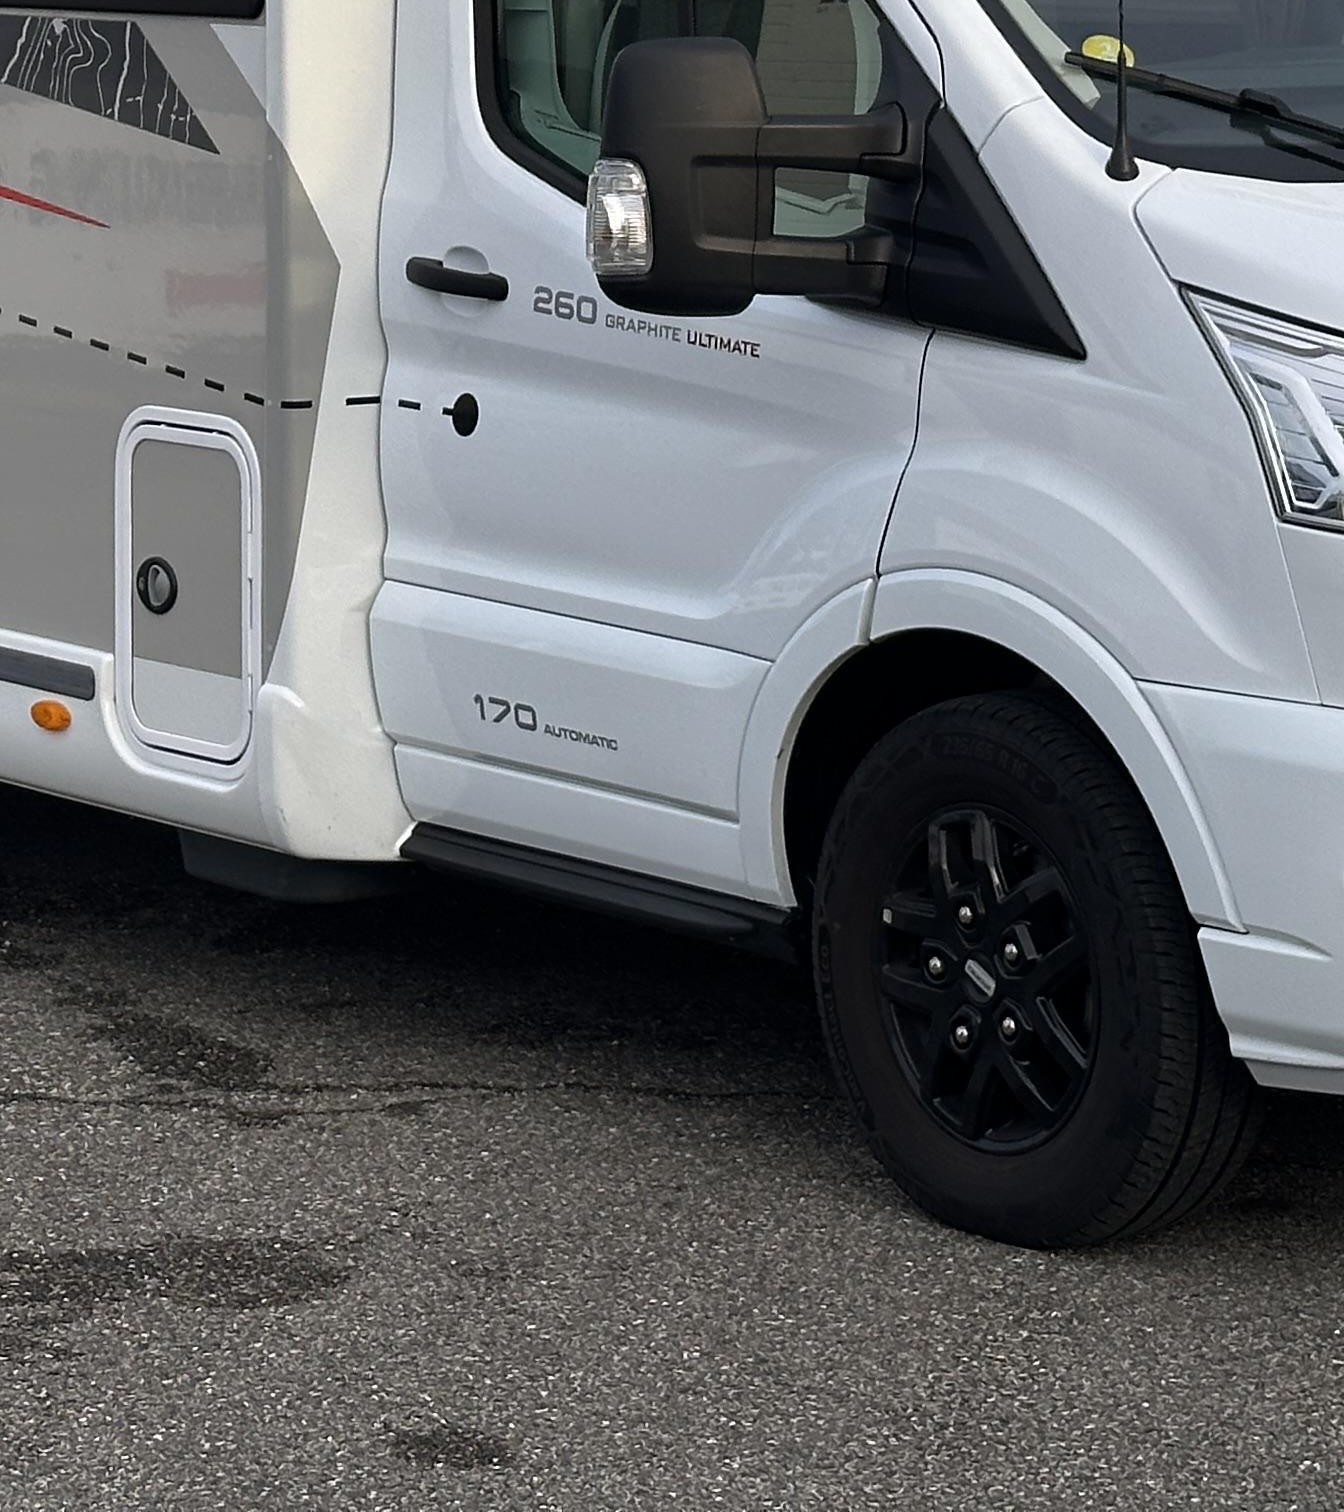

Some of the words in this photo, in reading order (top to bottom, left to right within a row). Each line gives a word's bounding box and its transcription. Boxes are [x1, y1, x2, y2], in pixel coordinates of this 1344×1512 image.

[533, 285, 598, 325] 260
[605, 313, 681, 343] GRAPHITE
[687, 329, 760, 358] ULTIMATE
[474, 694, 538, 731] 170
[544, 724, 619, 751] AUTOMATIC
